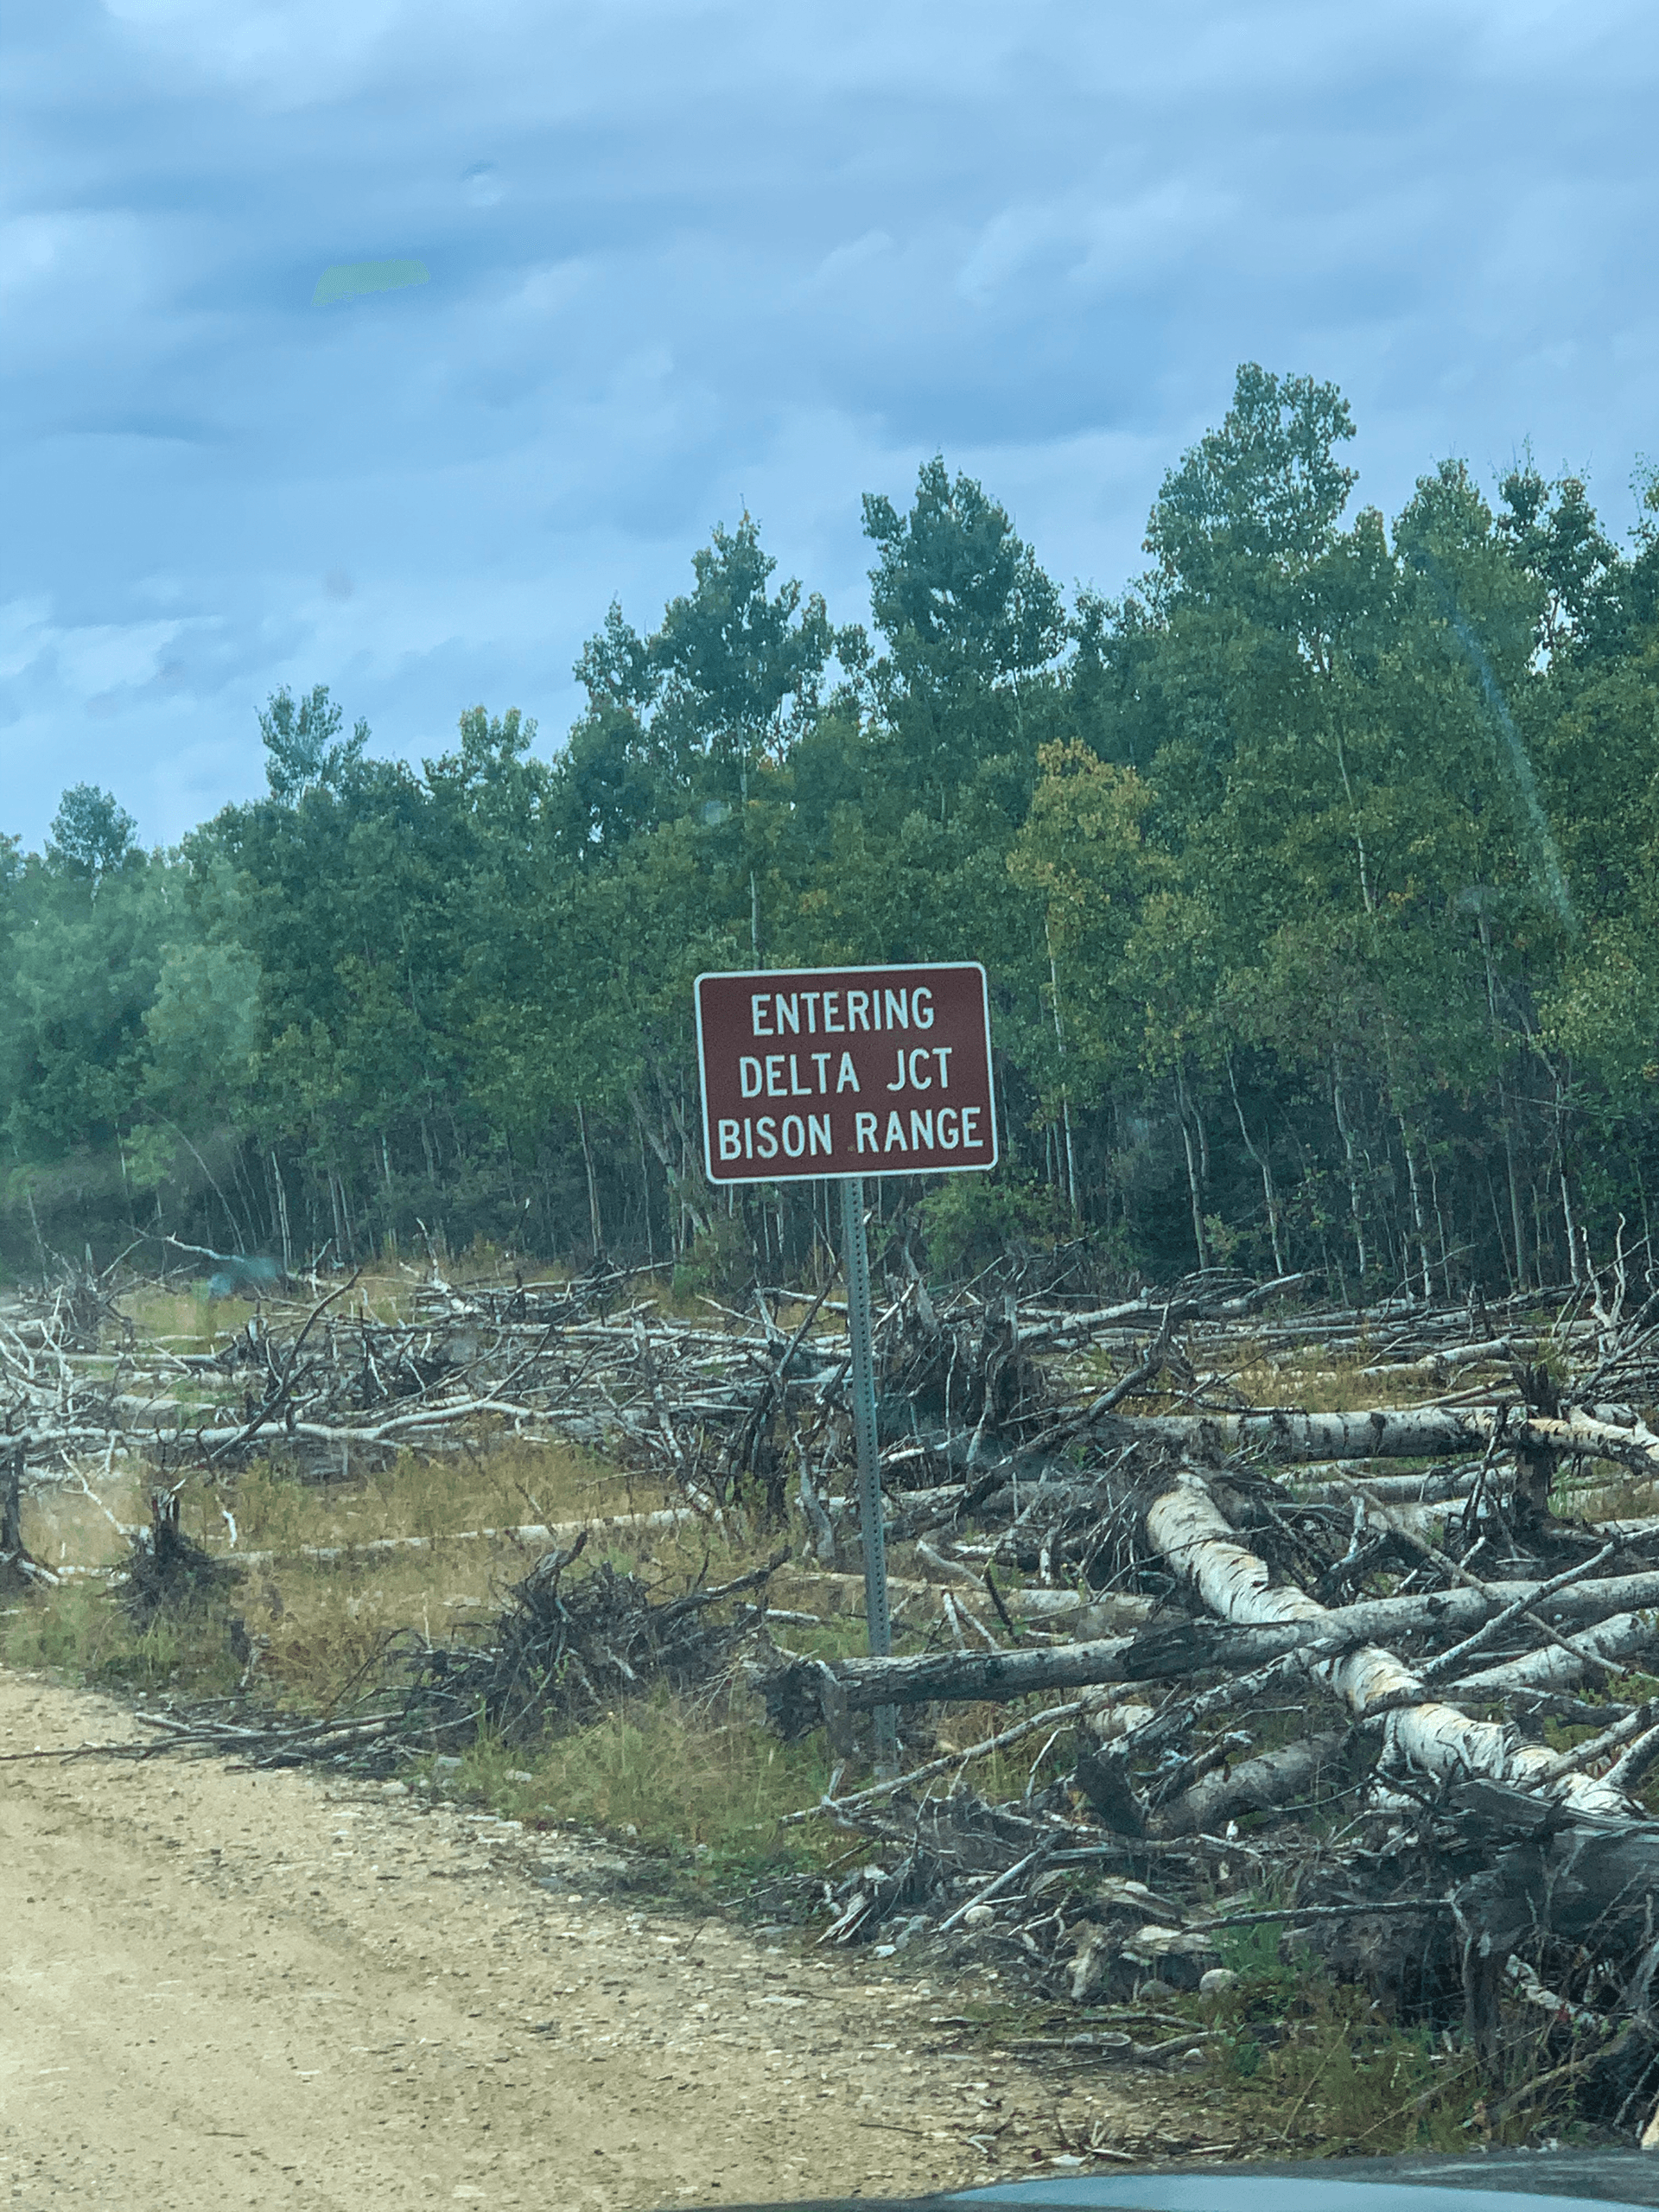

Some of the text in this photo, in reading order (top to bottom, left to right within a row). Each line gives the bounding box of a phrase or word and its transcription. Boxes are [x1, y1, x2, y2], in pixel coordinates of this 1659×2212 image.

[751, 987, 935, 1036] ENTERING
[739, 1047, 953, 1097] DELTA JCT
[718, 1107, 984, 1161] BISON RANGE
